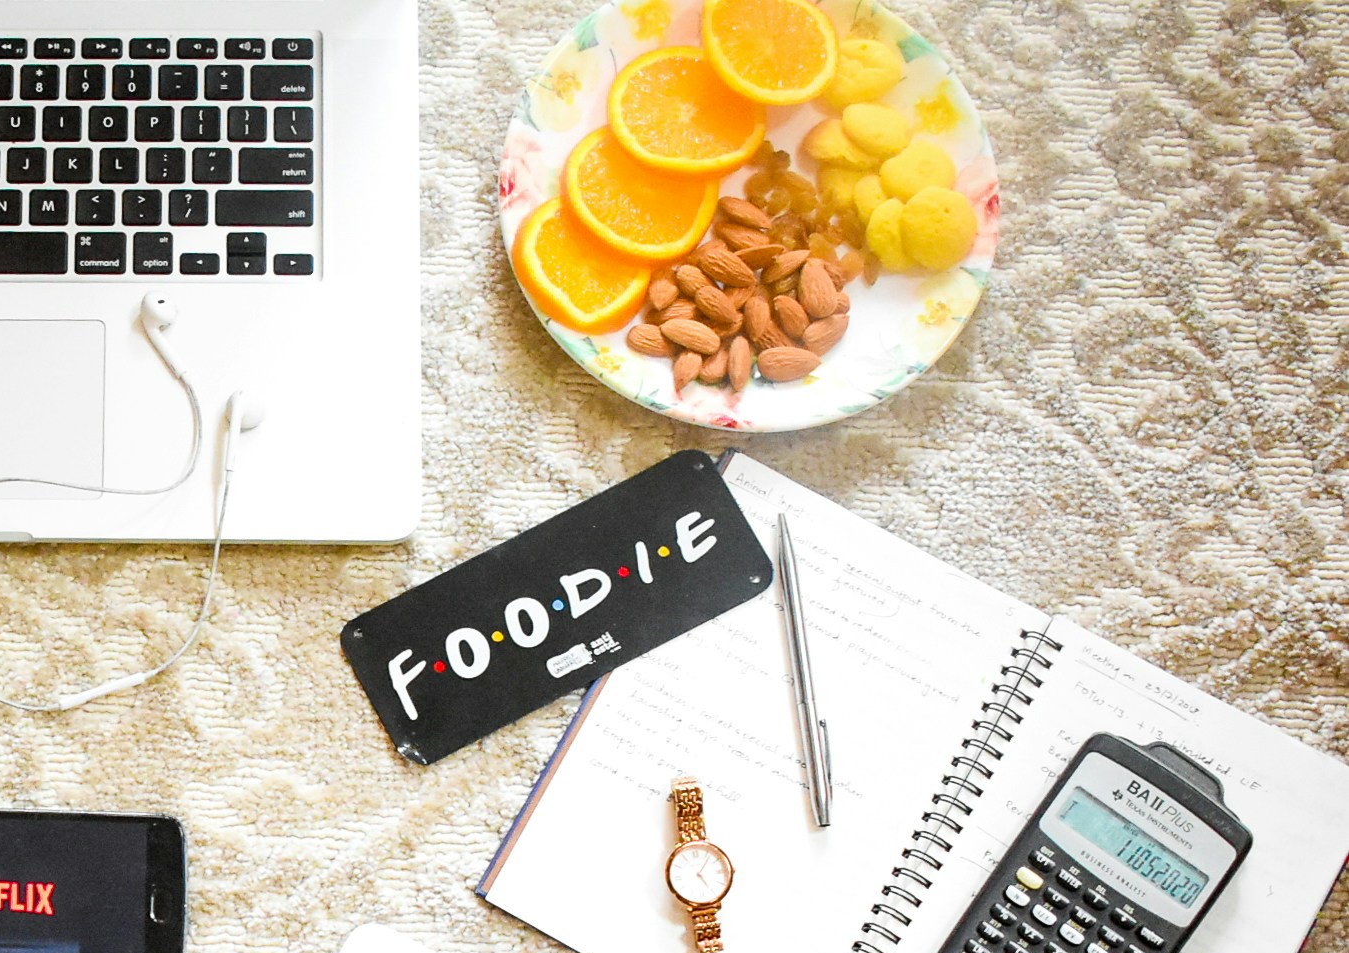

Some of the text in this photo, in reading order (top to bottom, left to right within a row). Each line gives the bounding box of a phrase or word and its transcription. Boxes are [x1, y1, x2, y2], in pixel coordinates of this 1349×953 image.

[35, 82, 44, 93] 8
[81, 81, 90, 93] 9
[127, 81, 137, 93] 0
[280, 84, 306, 93] delete
[10, 116, 21, 128] U
[102, 116, 114, 128] O
[150, 116, 159, 128] P
[22, 158, 30, 170] J
[68, 158, 78, 170] K
[115, 158, 123, 170] L
[281, 168, 307, 177] return
[41, 200, 55, 212] M
[287, 209, 306, 219] shift
[79, 258, 120, 268] command
[142, 258, 169, 269] option
[1080, 850, 1146, 898] BUSINESS ANALYST
